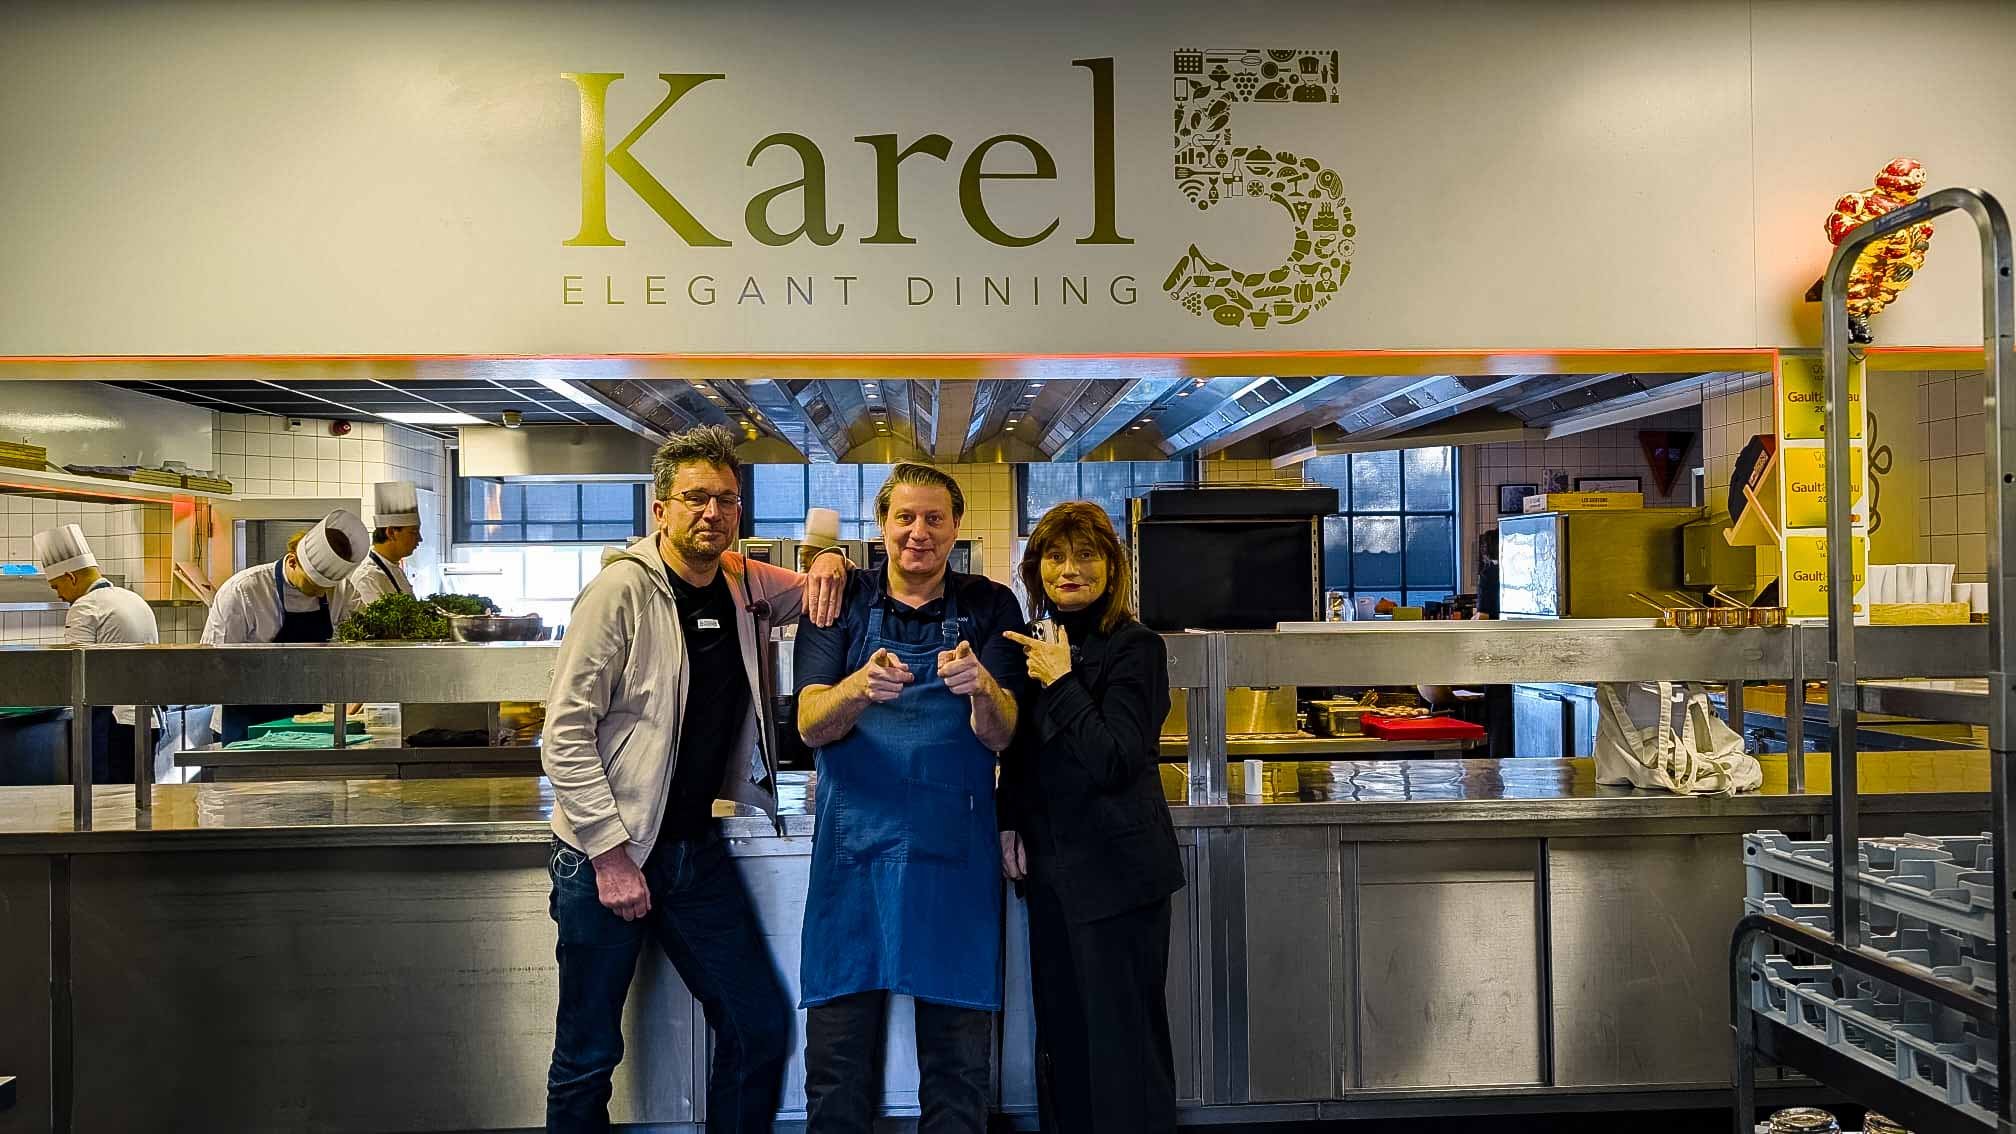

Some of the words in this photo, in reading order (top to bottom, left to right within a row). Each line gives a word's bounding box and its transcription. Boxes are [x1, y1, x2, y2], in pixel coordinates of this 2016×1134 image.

[559, 57, 1136, 248] Karel
[562, 275, 859, 306] ELEGANT
[907, 275, 1139, 306] DINING
